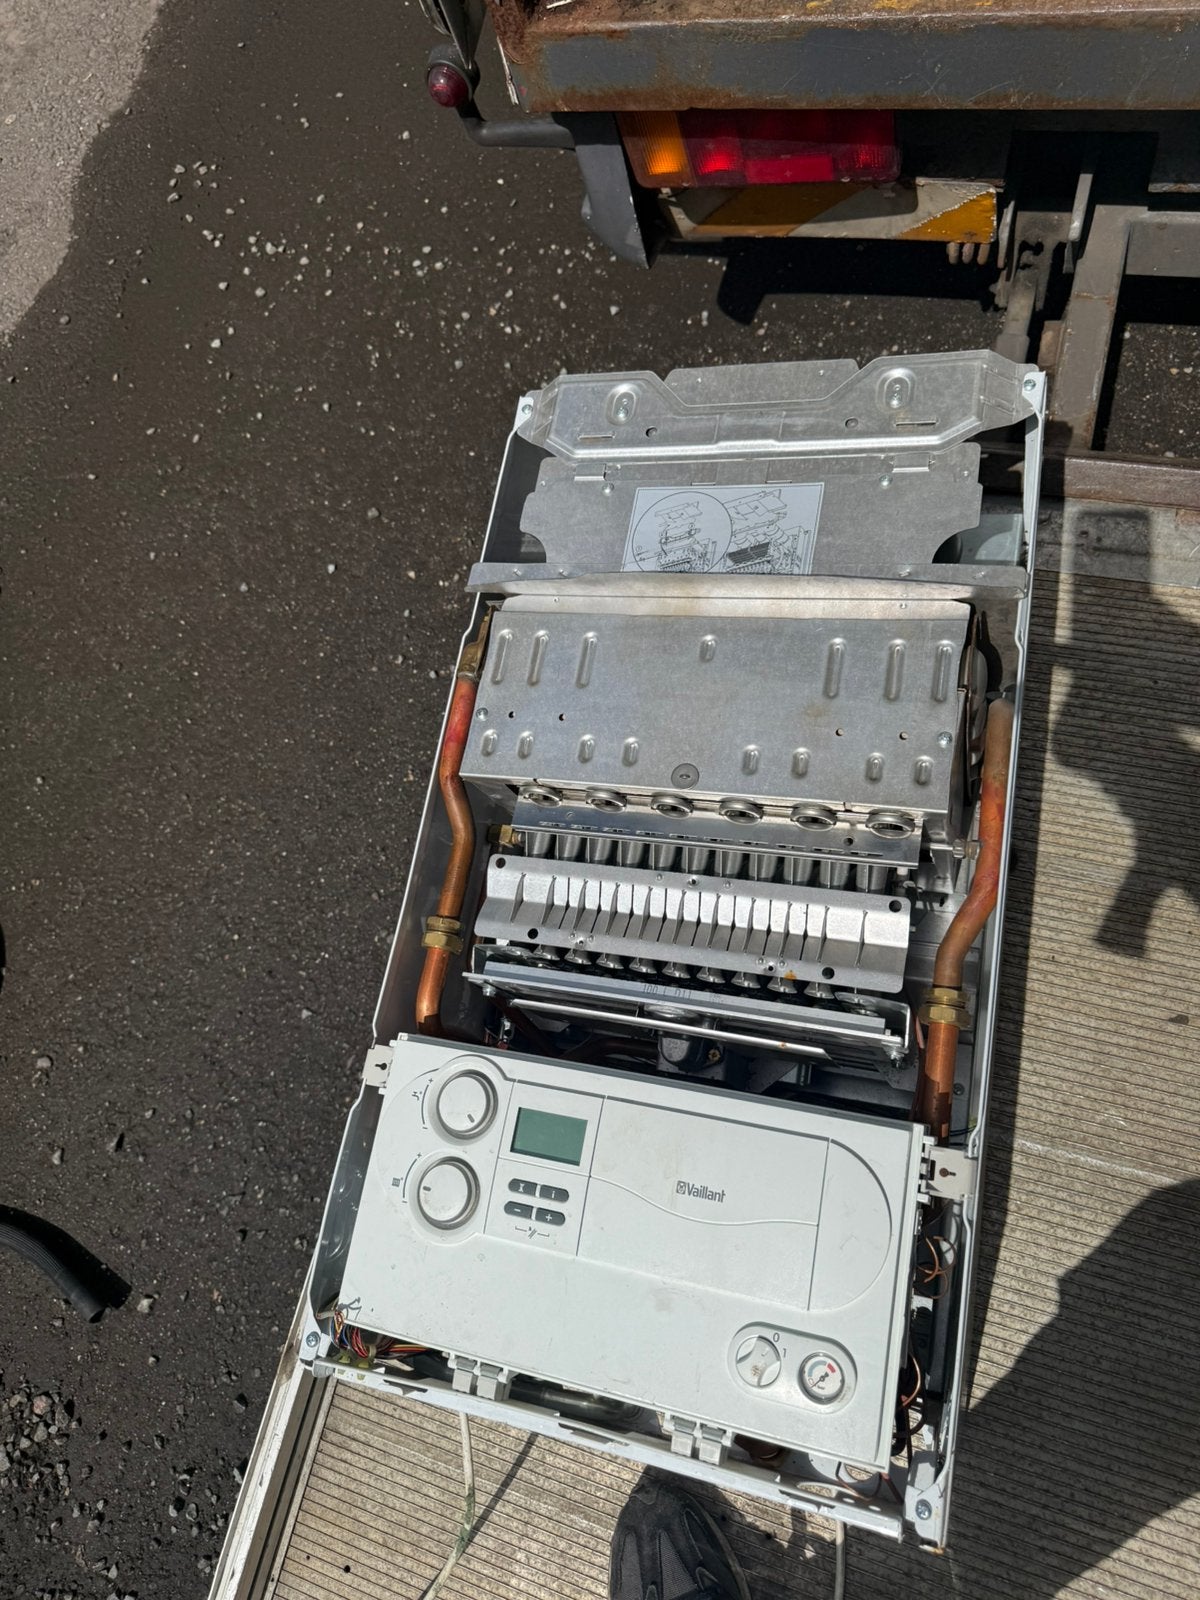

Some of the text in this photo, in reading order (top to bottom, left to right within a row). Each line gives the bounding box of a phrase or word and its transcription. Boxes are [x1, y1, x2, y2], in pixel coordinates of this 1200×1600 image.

[686, 1182, 726, 1203] Vaillant
[772, 1332, 780, 1343] 0
[782, 1347, 787, 1358] 1
